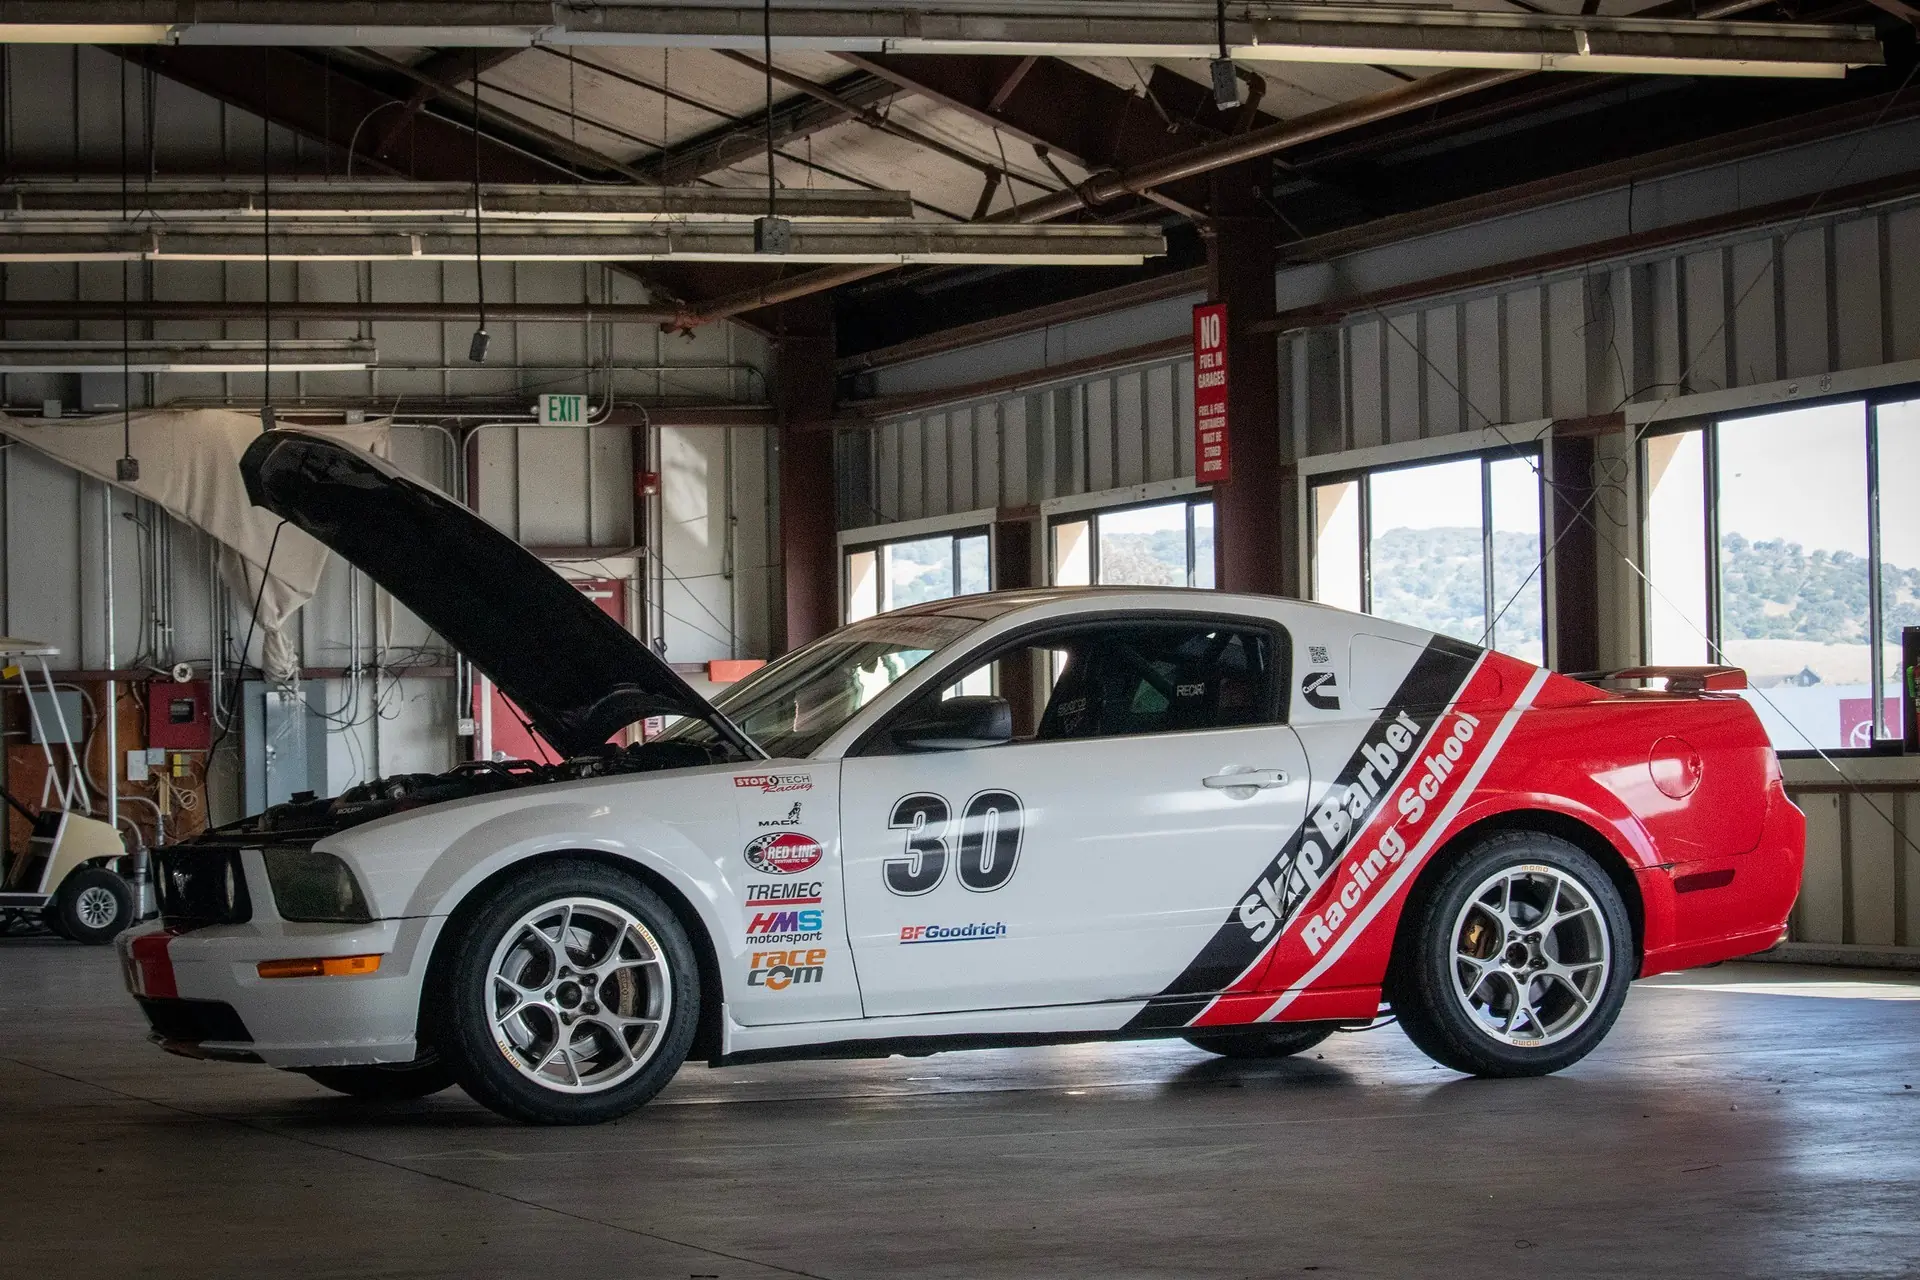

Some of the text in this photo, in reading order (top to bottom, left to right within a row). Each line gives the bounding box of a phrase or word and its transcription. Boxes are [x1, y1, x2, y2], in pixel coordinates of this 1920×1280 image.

[1201, 313, 1220, 349] NO
[1200, 351, 1223, 369] FUEL IN
[1198, 370, 1225, 388] GARAGES
[548, 396, 581, 422] EXIT
[1303, 671, 1333, 694] Cummins
[761, 783, 814, 795] Racing
[758, 819, 800, 827] MACK
[1238, 710, 1422, 942] Skip Barber
[882, 788, 1025, 897] 30
[1299, 711, 1481, 956] Racing School
[767, 844, 817, 860] RED LINE
[747, 882, 822, 900] TREMEC
[746, 909, 823, 934] HMS
[900, 921, 1006, 940] BFGoodrich
[746, 932, 822, 945] motorsport
[751, 949, 827, 969] race
